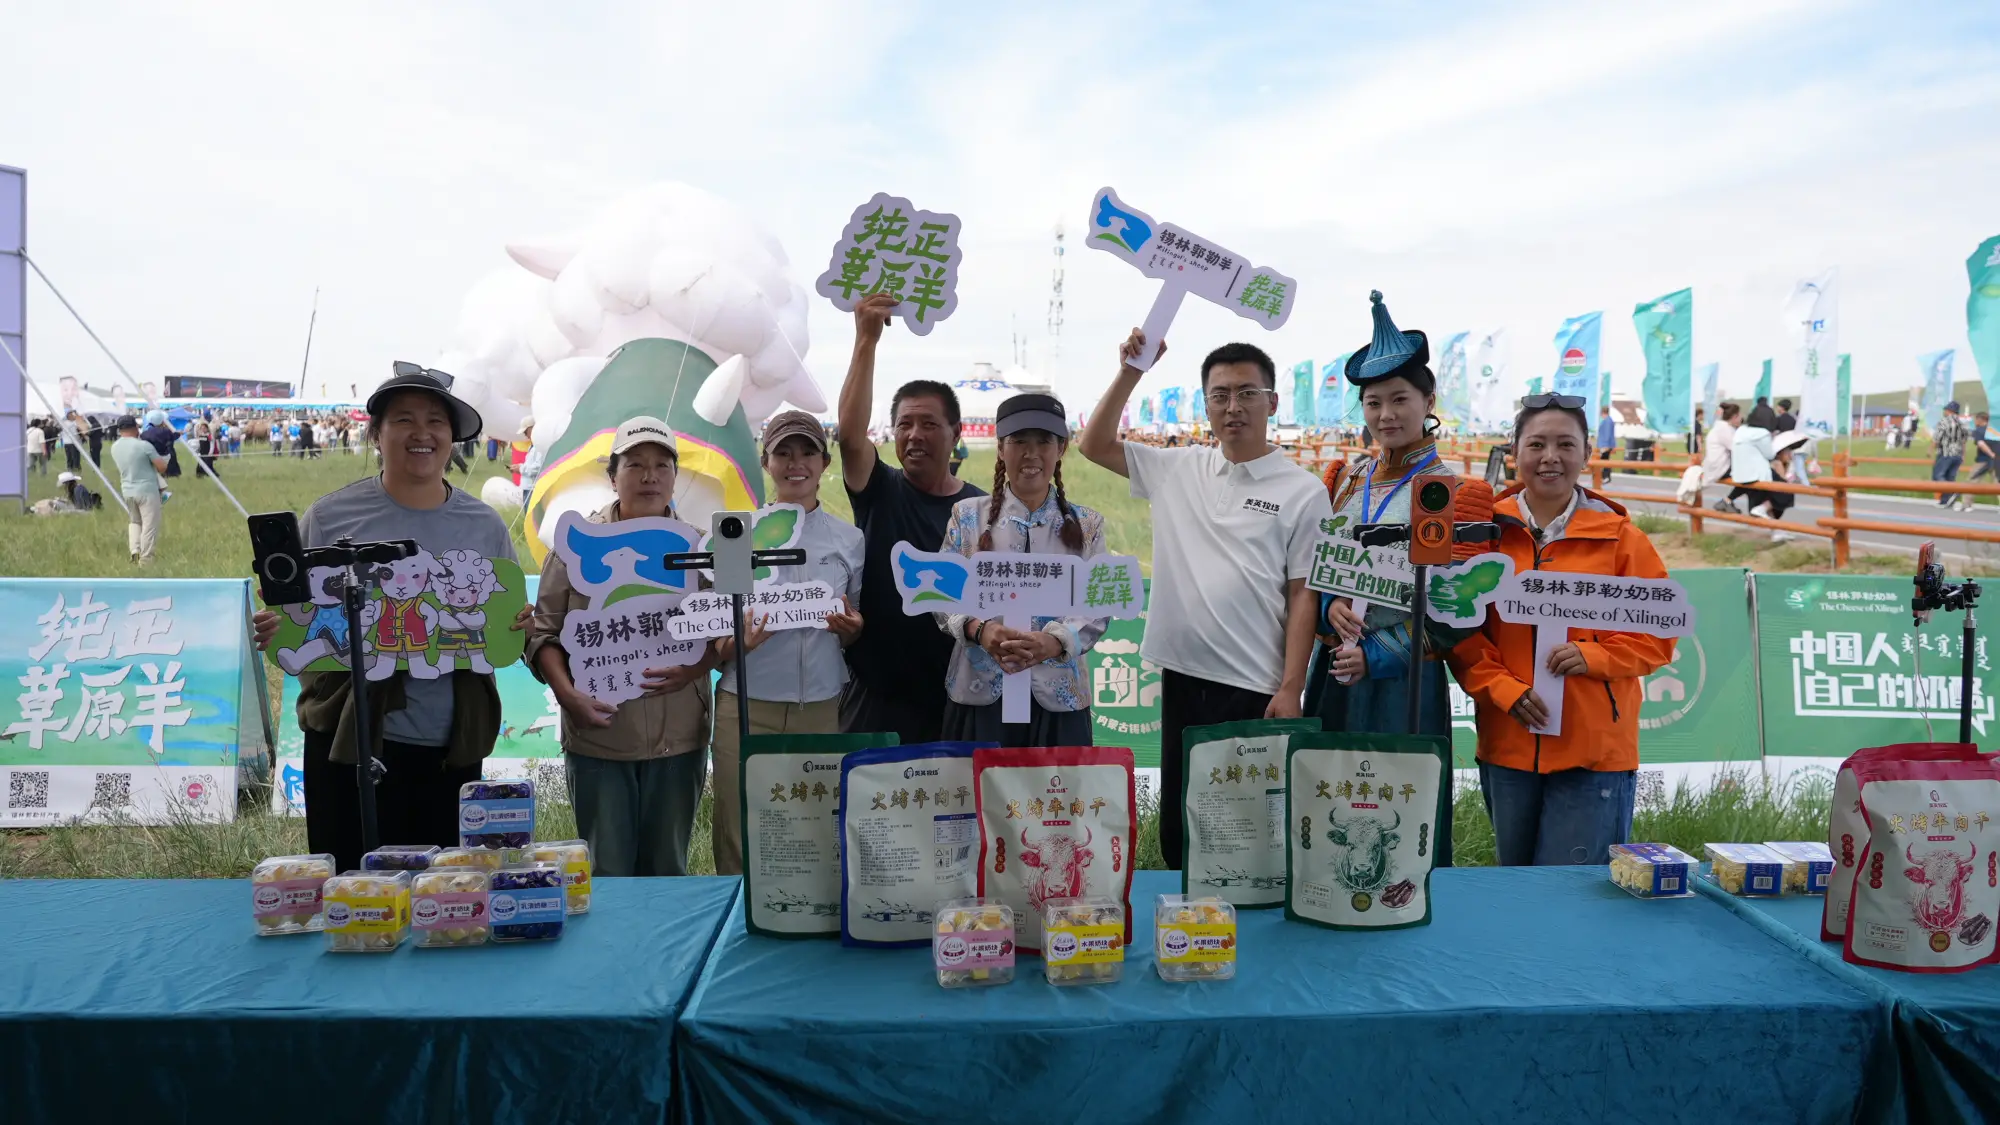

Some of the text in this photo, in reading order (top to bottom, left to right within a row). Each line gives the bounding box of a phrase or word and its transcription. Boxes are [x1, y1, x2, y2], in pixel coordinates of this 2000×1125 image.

[853, 204, 951, 263] 纯正
[1156, 244, 1188, 264] Xilingol's
[1189, 260, 1209, 272] sheep
[1160, 229, 1233, 271] 锡林郭勒羊
[827, 246, 948, 324] 草原羊
[1250, 271, 1288, 299] 纯正
[1236, 285, 1287, 320] 草原羊
[627, 426, 668, 438] BALENCIAGA
[1315, 540, 1374, 570] 中国人
[976, 560, 1064, 580] 锡林郭勒羊
[1088, 563, 1131, 584] 纯正
[978, 579, 1042, 590] Xilingol's sheep
[1083, 583, 1135, 610] 草原羊
[1520, 577, 1677, 603] 锡林郭勒奶酪
[688, 586, 826, 613] 锡林郭勒奶酪
[28, 590, 185, 663] 纯正
[674, 604, 839, 635] The Chee of Xilingol
[1504, 599, 1687, 629] The Cheese of Xilingol
[582, 640, 694, 671] Xilingol's sheep
[1790, 630, 1900, 670] 中国人
[1, 660, 193, 754] 草原羊
[870, 785, 971, 812] 火烤牛肉干
[1315, 779, 1417, 804] 火烤牛肉干
[1005, 796, 1107, 820] 火烤牛肉干
[1888, 810, 1990, 834] 火烤牛肉干
